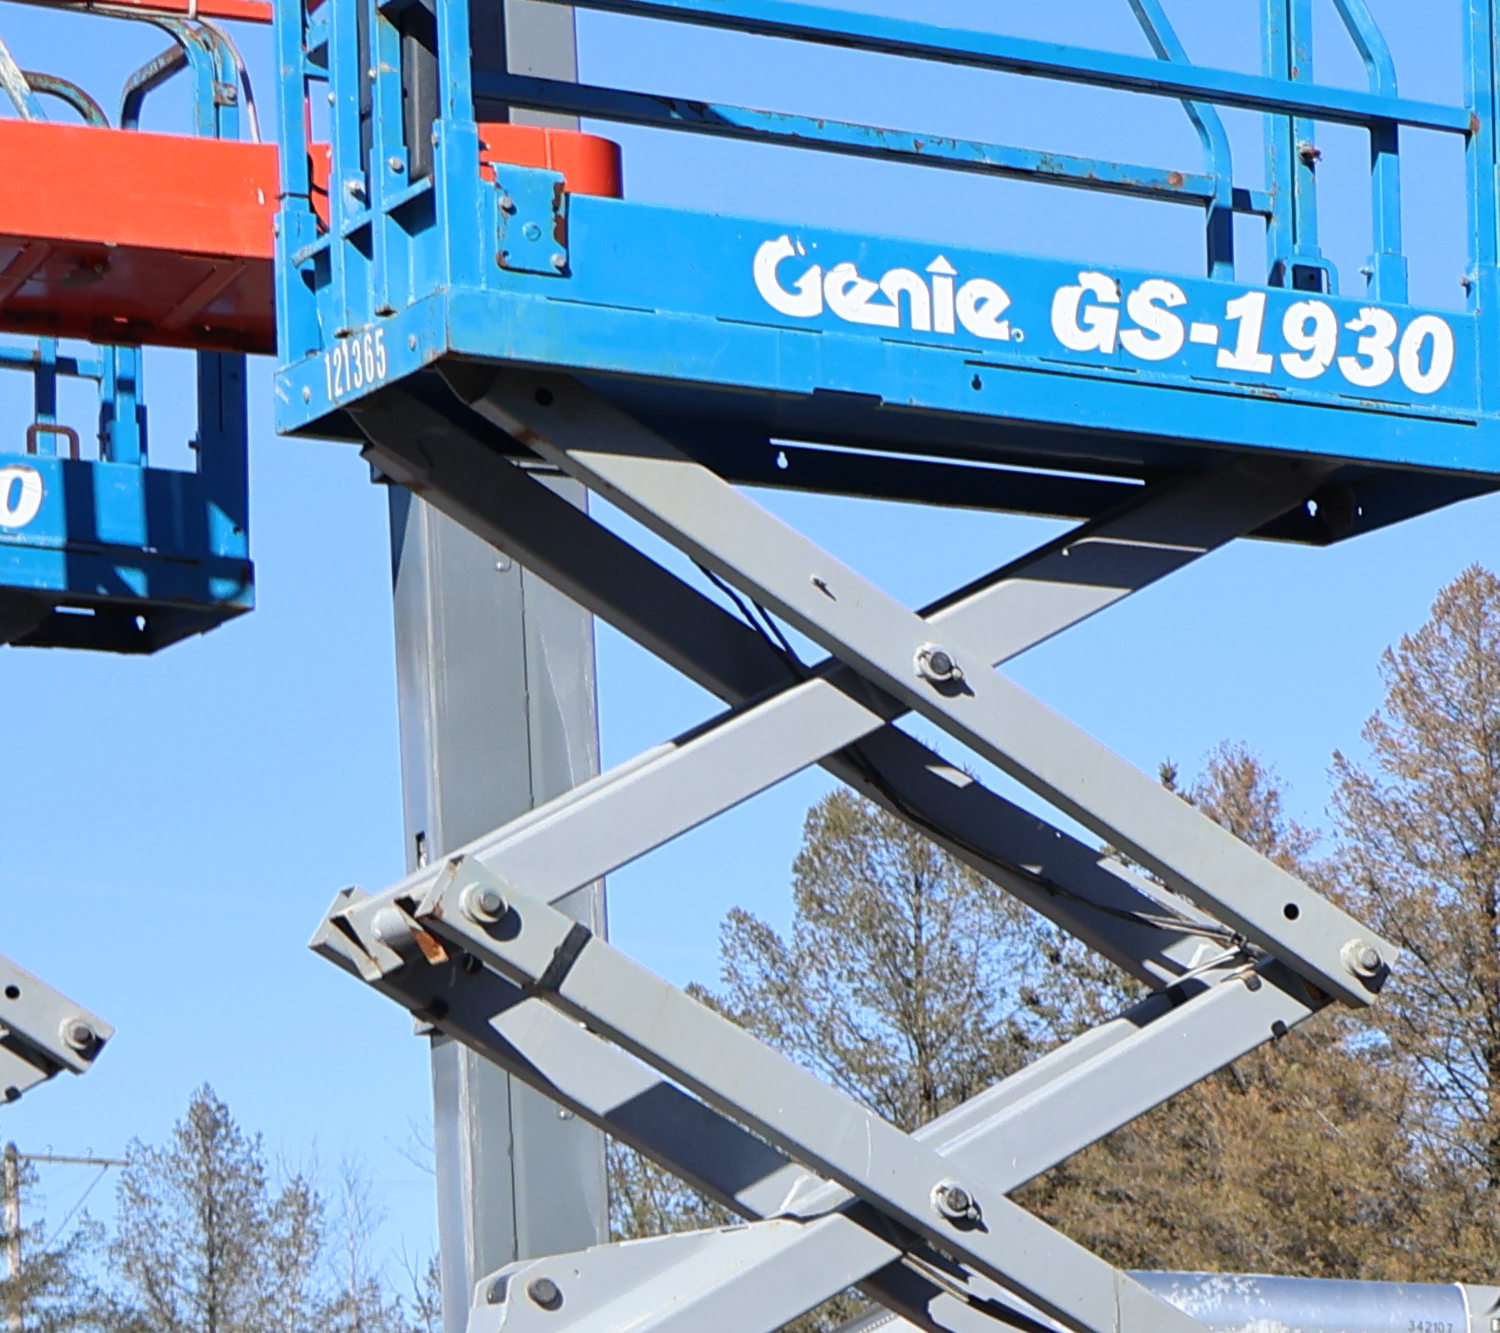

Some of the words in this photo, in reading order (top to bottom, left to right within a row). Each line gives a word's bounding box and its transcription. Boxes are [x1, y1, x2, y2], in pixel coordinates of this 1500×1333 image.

[324, 327, 387, 401] 121365
[752, 235, 1013, 341] Genie
[1051, 270, 1455, 395] GS-1930
